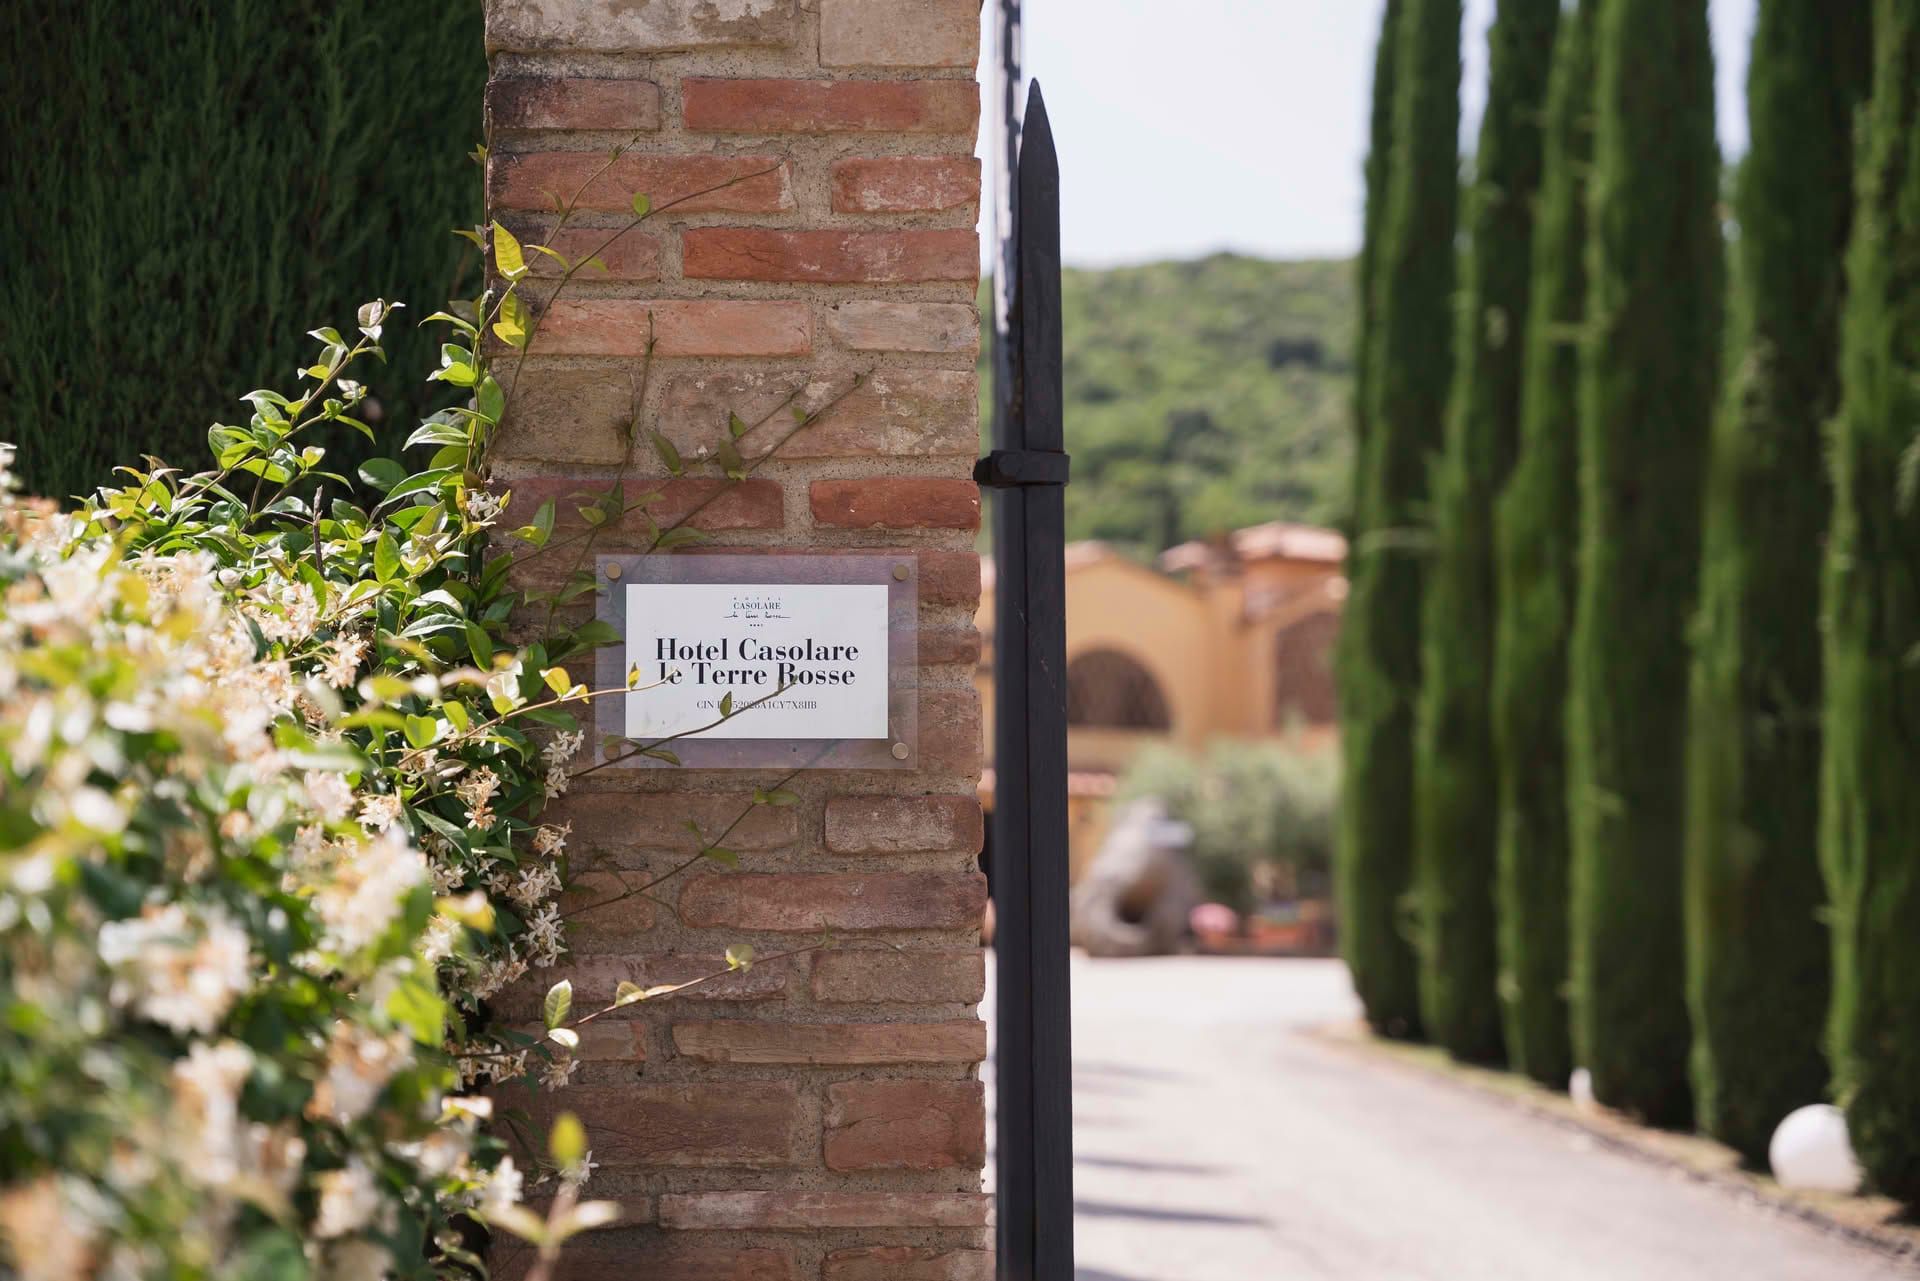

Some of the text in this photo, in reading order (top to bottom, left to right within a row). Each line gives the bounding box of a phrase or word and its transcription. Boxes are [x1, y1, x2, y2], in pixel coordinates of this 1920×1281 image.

[733, 602, 782, 610] CASOLARE
[655, 637, 860, 661] Hotel Casolare
[659, 662, 857, 685] le Terre Rosse
[696, 700, 715, 709] CIN
